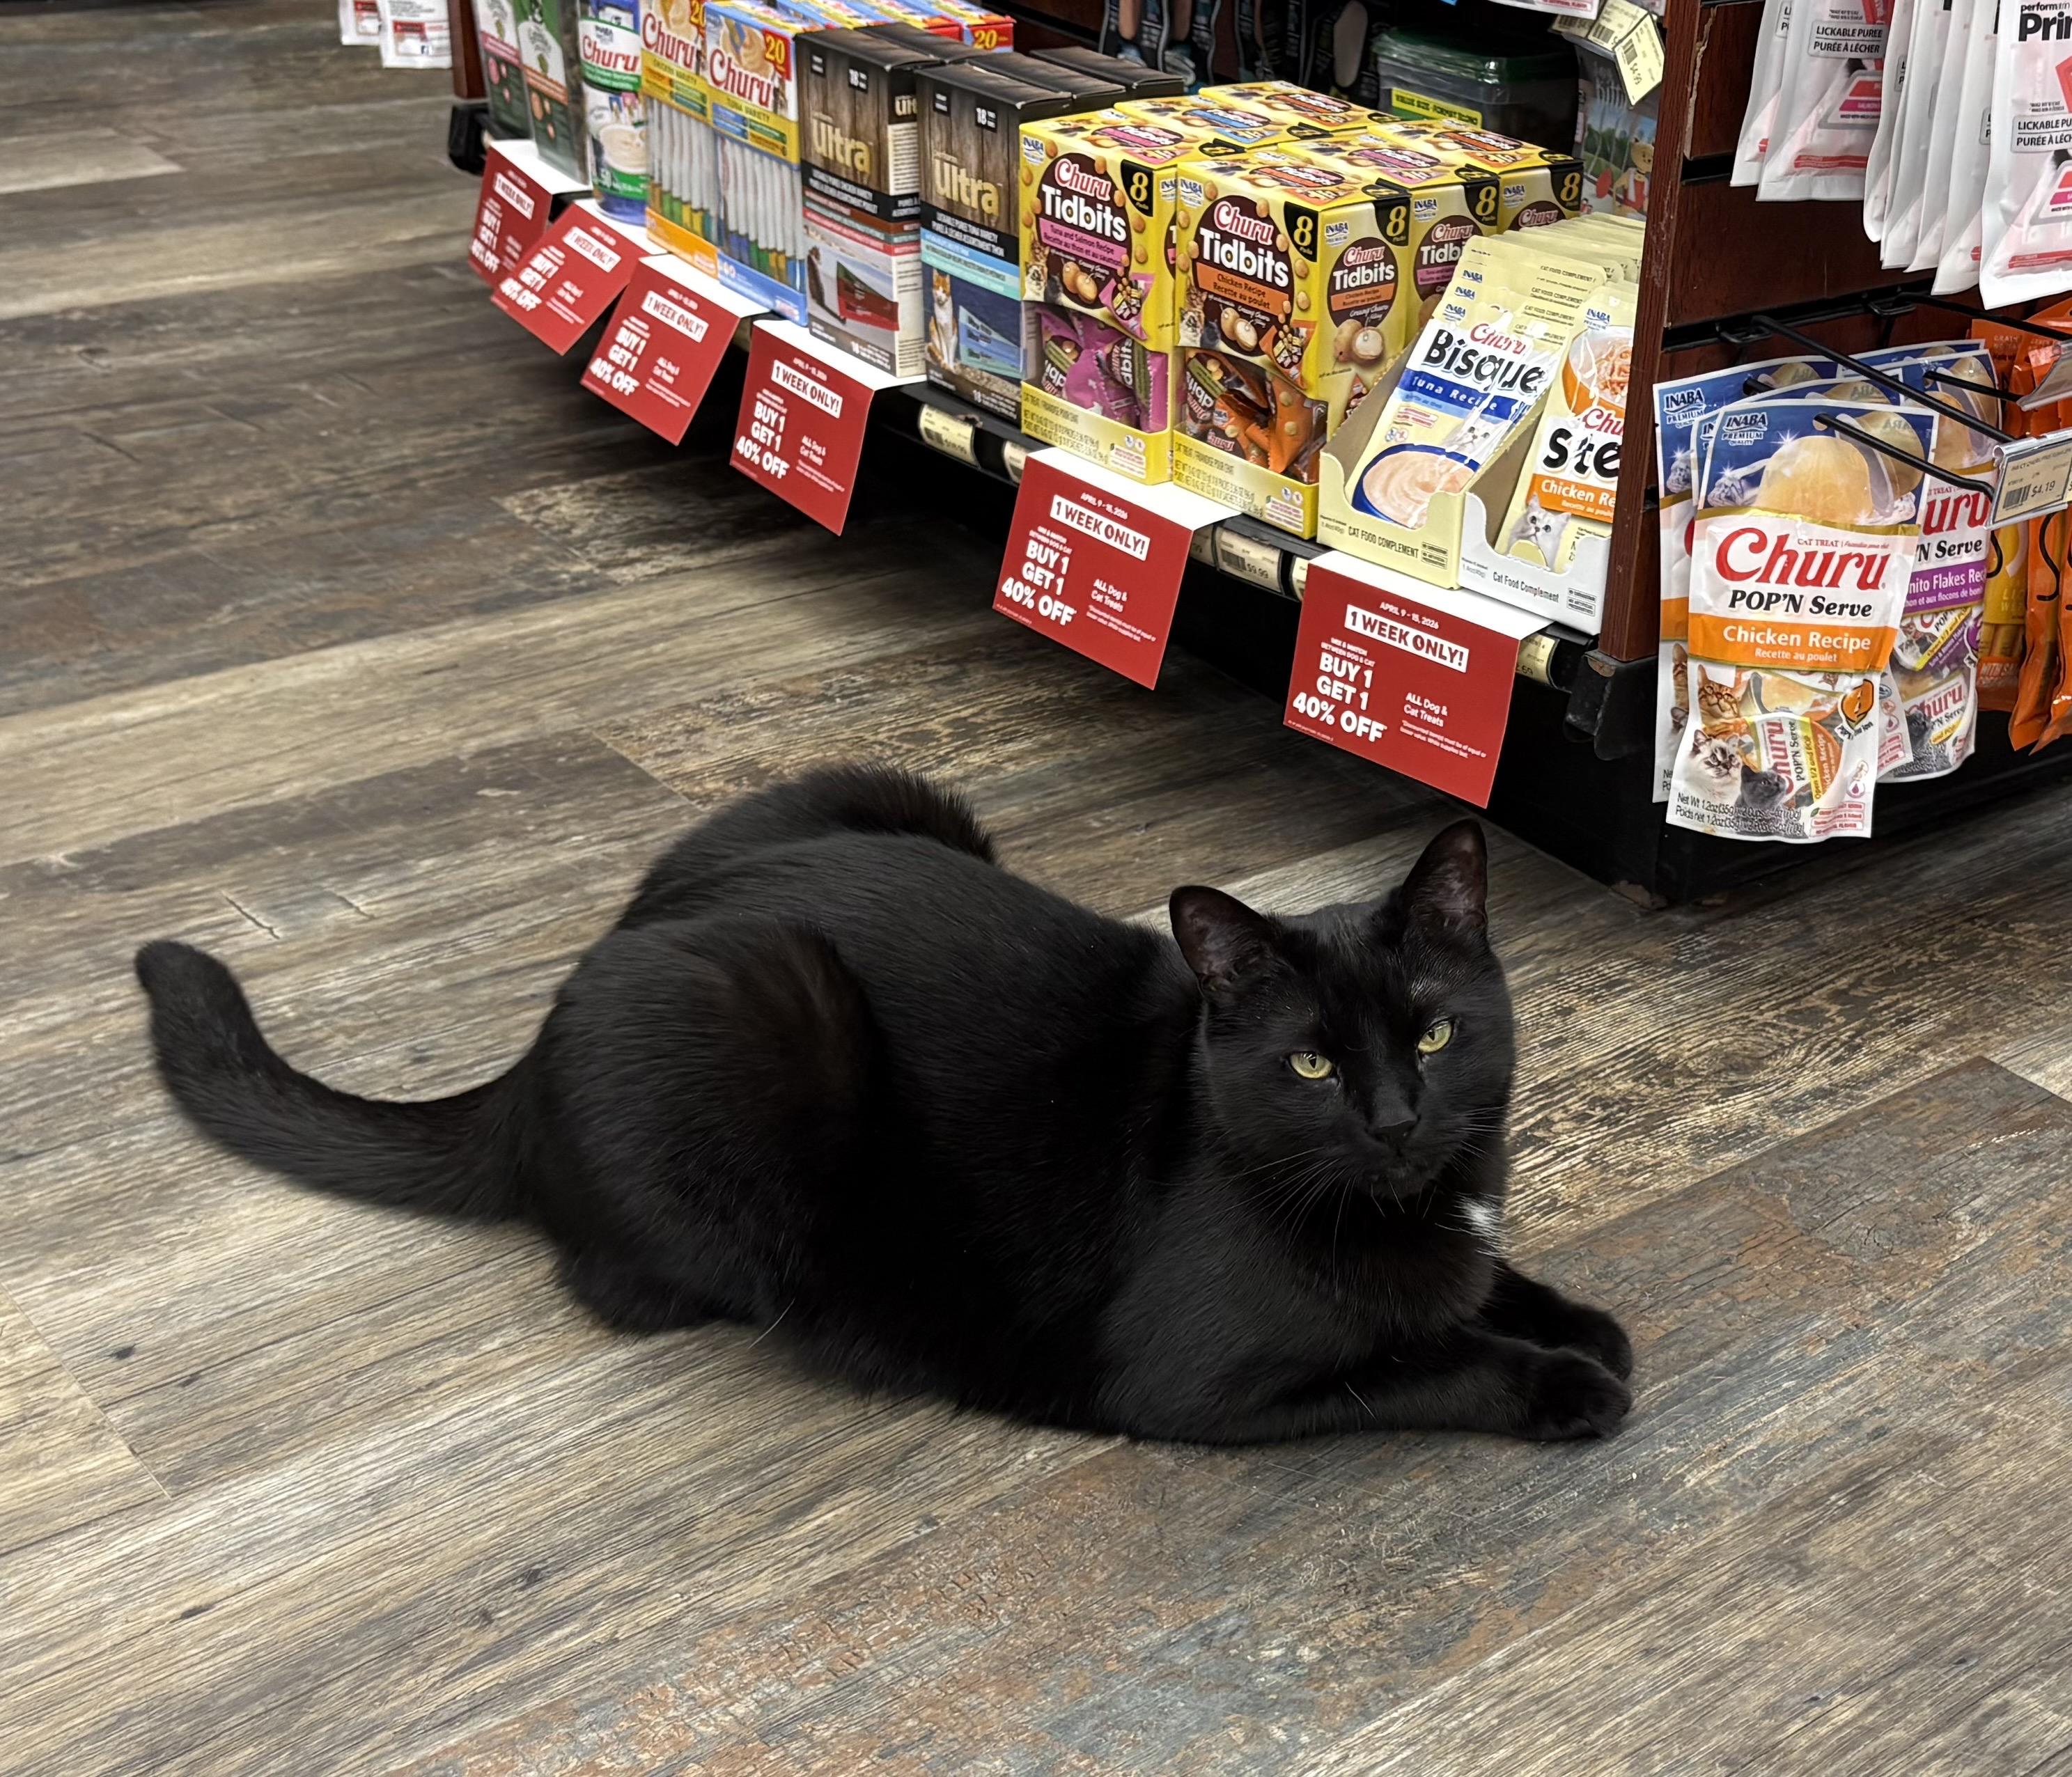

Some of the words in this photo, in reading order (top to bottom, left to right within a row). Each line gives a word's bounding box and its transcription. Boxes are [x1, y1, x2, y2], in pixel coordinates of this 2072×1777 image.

[642, 13, 695, 69] Churu
[974, 31, 997, 49] 20
[1816, 25, 1856, 37] LICKABLE
[582, 35, 639, 72] Churu
[766, 36, 786, 63] 20
[1814, 41, 1841, 52] PURÉE
[1850, 40, 1880, 54] LÉCHER
[710, 49, 772, 108] Churu
[849, 69, 859, 86] 18
[745, 104, 770, 122] VARIETY
[976, 107, 987, 125] 18
[1434, 104, 1457, 118] FORMAT
[2018, 118, 2059, 130] LICKABLE
[813, 116, 870, 174] Ultra
[2017, 134, 2047, 146] PURÉE
[2048, 134, 2055, 144] À
[933, 159, 999, 215] Ultra
[1056, 159, 1111, 201] Churu
[1130, 172, 1148, 201] 8
[1181, 179, 1202, 194] INABA
[1504, 184, 1525, 196] INABA
[1560, 173, 1581, 202] 8
[1042, 185, 1126, 242] Tidbits
[1414, 198, 1438, 212] INABA
[1475, 186, 1496, 217] 8
[1215, 201, 1273, 244] Churu
[1293, 216, 1313, 246] 8
[1325, 222, 1349, 236] INABA
[1386, 205, 1407, 237] 8
[1518, 208, 1559, 227] Churu
[1064, 229, 1073, 240] and
[1074, 233, 1095, 247] Salmon
[1431, 223, 1473, 243] Churu
[1200, 228, 1288, 287] Tidbits
[1343, 244, 1385, 267] Churu
[1217, 274, 1243, 289] Chicken
[1244, 283, 1265, 298] Recipe
[1332, 263, 1395, 291] Tidbits
[1463, 269, 1483, 283] INABA
[1562, 270, 1592, 281] COMPLEMENT
[1213, 282, 1238, 297] Recette
[1248, 296, 1270, 310] poulet
[1454, 286, 1476, 300] INABA
[1554, 292, 1582, 304] COMPLEMENT
[648, 297, 653, 306] 1
[654, 300, 676, 321] WEEK
[677, 313, 703, 337] ONLY!
[1444, 303, 1466, 317] INABA
[1546, 310, 1574, 320] COMPLEMENT
[1587, 308, 1610, 322] INABA
[616, 327, 639, 351] BUY
[638, 339, 646, 355] 1
[1470, 322, 1527, 354] Churu
[609, 344, 632, 367] GET
[630, 356, 639, 372] 1
[1423, 329, 1548, 393] Bisque
[589, 358, 615, 384] 40%
[612, 370, 639, 396] OFF
[776, 366, 780, 378] 1
[783, 368, 809, 396] WEEK
[810, 386, 840, 413] ONLY!
[1412, 377, 1443, 394] Tuna
[1449, 389, 1497, 411] Recie
[1665, 389, 1704, 409] INABA
[754, 401, 779, 428] BUY
[779, 415, 786, 432] 1
[1667, 410, 1705, 424] PREMIUM
[1726, 414, 1766, 427] INABA
[751, 421, 774, 446] GET
[774, 435, 781, 452] 1
[1722, 432, 1763, 440] PREMIUM
[736, 436, 761, 464] 40%
[762, 452, 790, 479] OFF
[1541, 479, 1594, 502] Chicken
[1056, 501, 1061, 515] 1
[1065, 504, 1103, 535] WEEK
[1105, 524, 1145, 554] ONLY!
[1026, 540, 1059, 568] BUY
[1061, 557, 1070, 574] 1
[1361, 529, 1377, 544] FOOD
[1378, 535, 1419, 559] COMPLEMENT
[1935, 539, 1982, 558] Serve
[1715, 527, 1892, 590] Churu
[1022, 561, 1054, 589] GET
[1056, 578, 1064, 595] 1
[1093, 579, 1107, 592] ALL
[1108, 585, 1121, 601] Dog
[1121, 592, 1128, 602] &
[1493, 572, 1504, 583] Cat
[1504, 575, 1520, 588] Food
[1520, 580, 1559, 604] Complement
[1932, 572, 1965, 590] Flakes
[1002, 577, 1034, 609] 40%
[1091, 590, 1104, 602] Cat
[1105, 596, 1123, 613] Treats
[1728, 589, 1804, 614] POP'N
[1809, 596, 1872, 617] Serve
[1925, 595, 1937, 604] aux
[1937, 590, 1960, 602] flocons
[1961, 589, 1968, 598] de
[1380, 602, 1400, 616] APRIL
[1421, 616, 1439, 629] 2026
[1350, 611, 1357, 627] 1
[1362, 614, 1409, 645] WEEK
[1412, 635, 1463, 666] ONLY!
[1723, 625, 1802, 647] Chicken
[1809, 631, 1871, 654] Recipe
[1754, 648, 1791, 659] Recette
[1806, 652, 1838, 662] poulet
[1320, 652, 1361, 682] BUY
[1363, 670, 1373, 689] 1
[1316, 675, 1356, 704] GET
[1360, 691, 1369, 710] 1
[1406, 693, 1423, 704] ALL
[1424, 698, 1441, 716] Dog
[1441, 705, 1447, 717] &
[1293, 692, 1336, 726] 40%
[1403, 705, 1419, 717] Cat
[1420, 710, 1444, 727] Treats
[1790, 720, 1800, 749] Serve
[1678, 792, 1690, 805] Net
[1691, 794, 1701, 806] Wt
[1676, 805, 1692, 819] Poids
[1693, 810, 1705, 822] net
